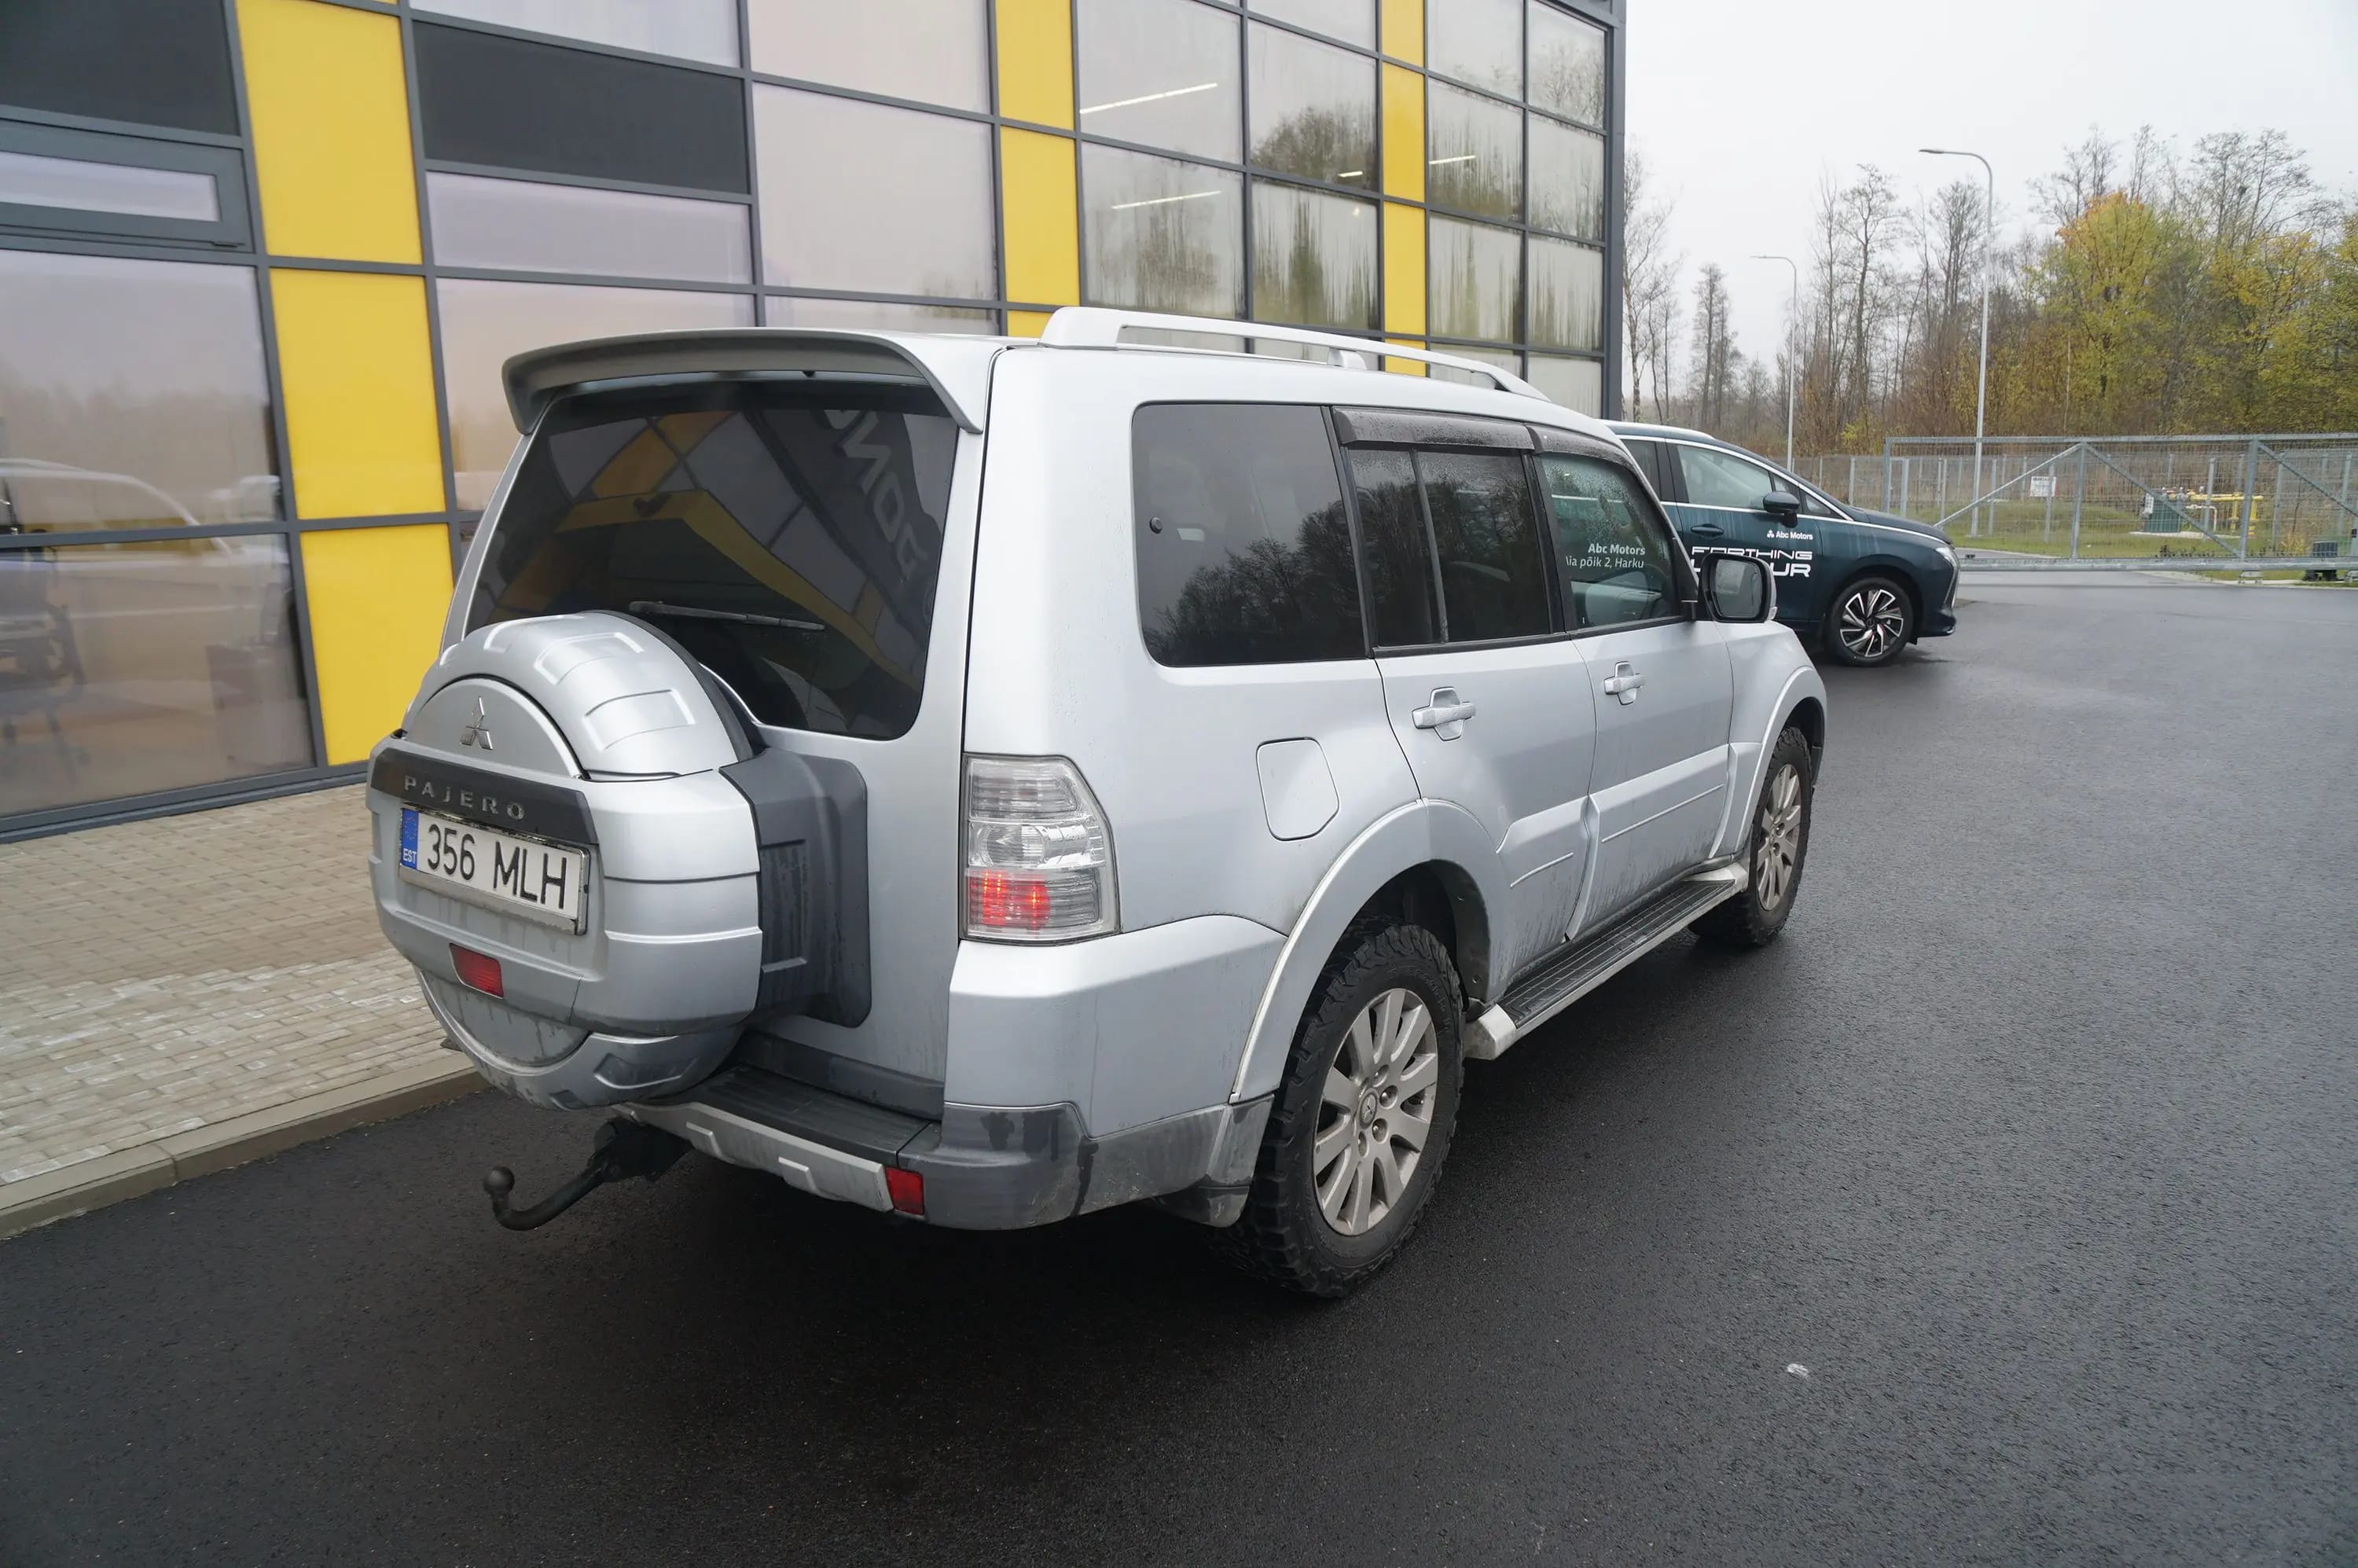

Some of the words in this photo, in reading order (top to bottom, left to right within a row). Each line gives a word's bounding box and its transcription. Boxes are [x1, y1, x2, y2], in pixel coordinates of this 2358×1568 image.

[1790, 531, 1813, 540] Motors
[1588, 543, 1607, 553] Abc
[1610, 544, 1646, 555] Motors
[1579, 556, 1602, 569] põik
[1604, 556, 1612, 569] 2,
[1614, 557, 1644, 568] Harku
[403, 775, 525, 820] PAJERO
[402, 848, 417, 864] EST
[427, 824, 476, 880] 356
[493, 840, 567, 909] MLH
